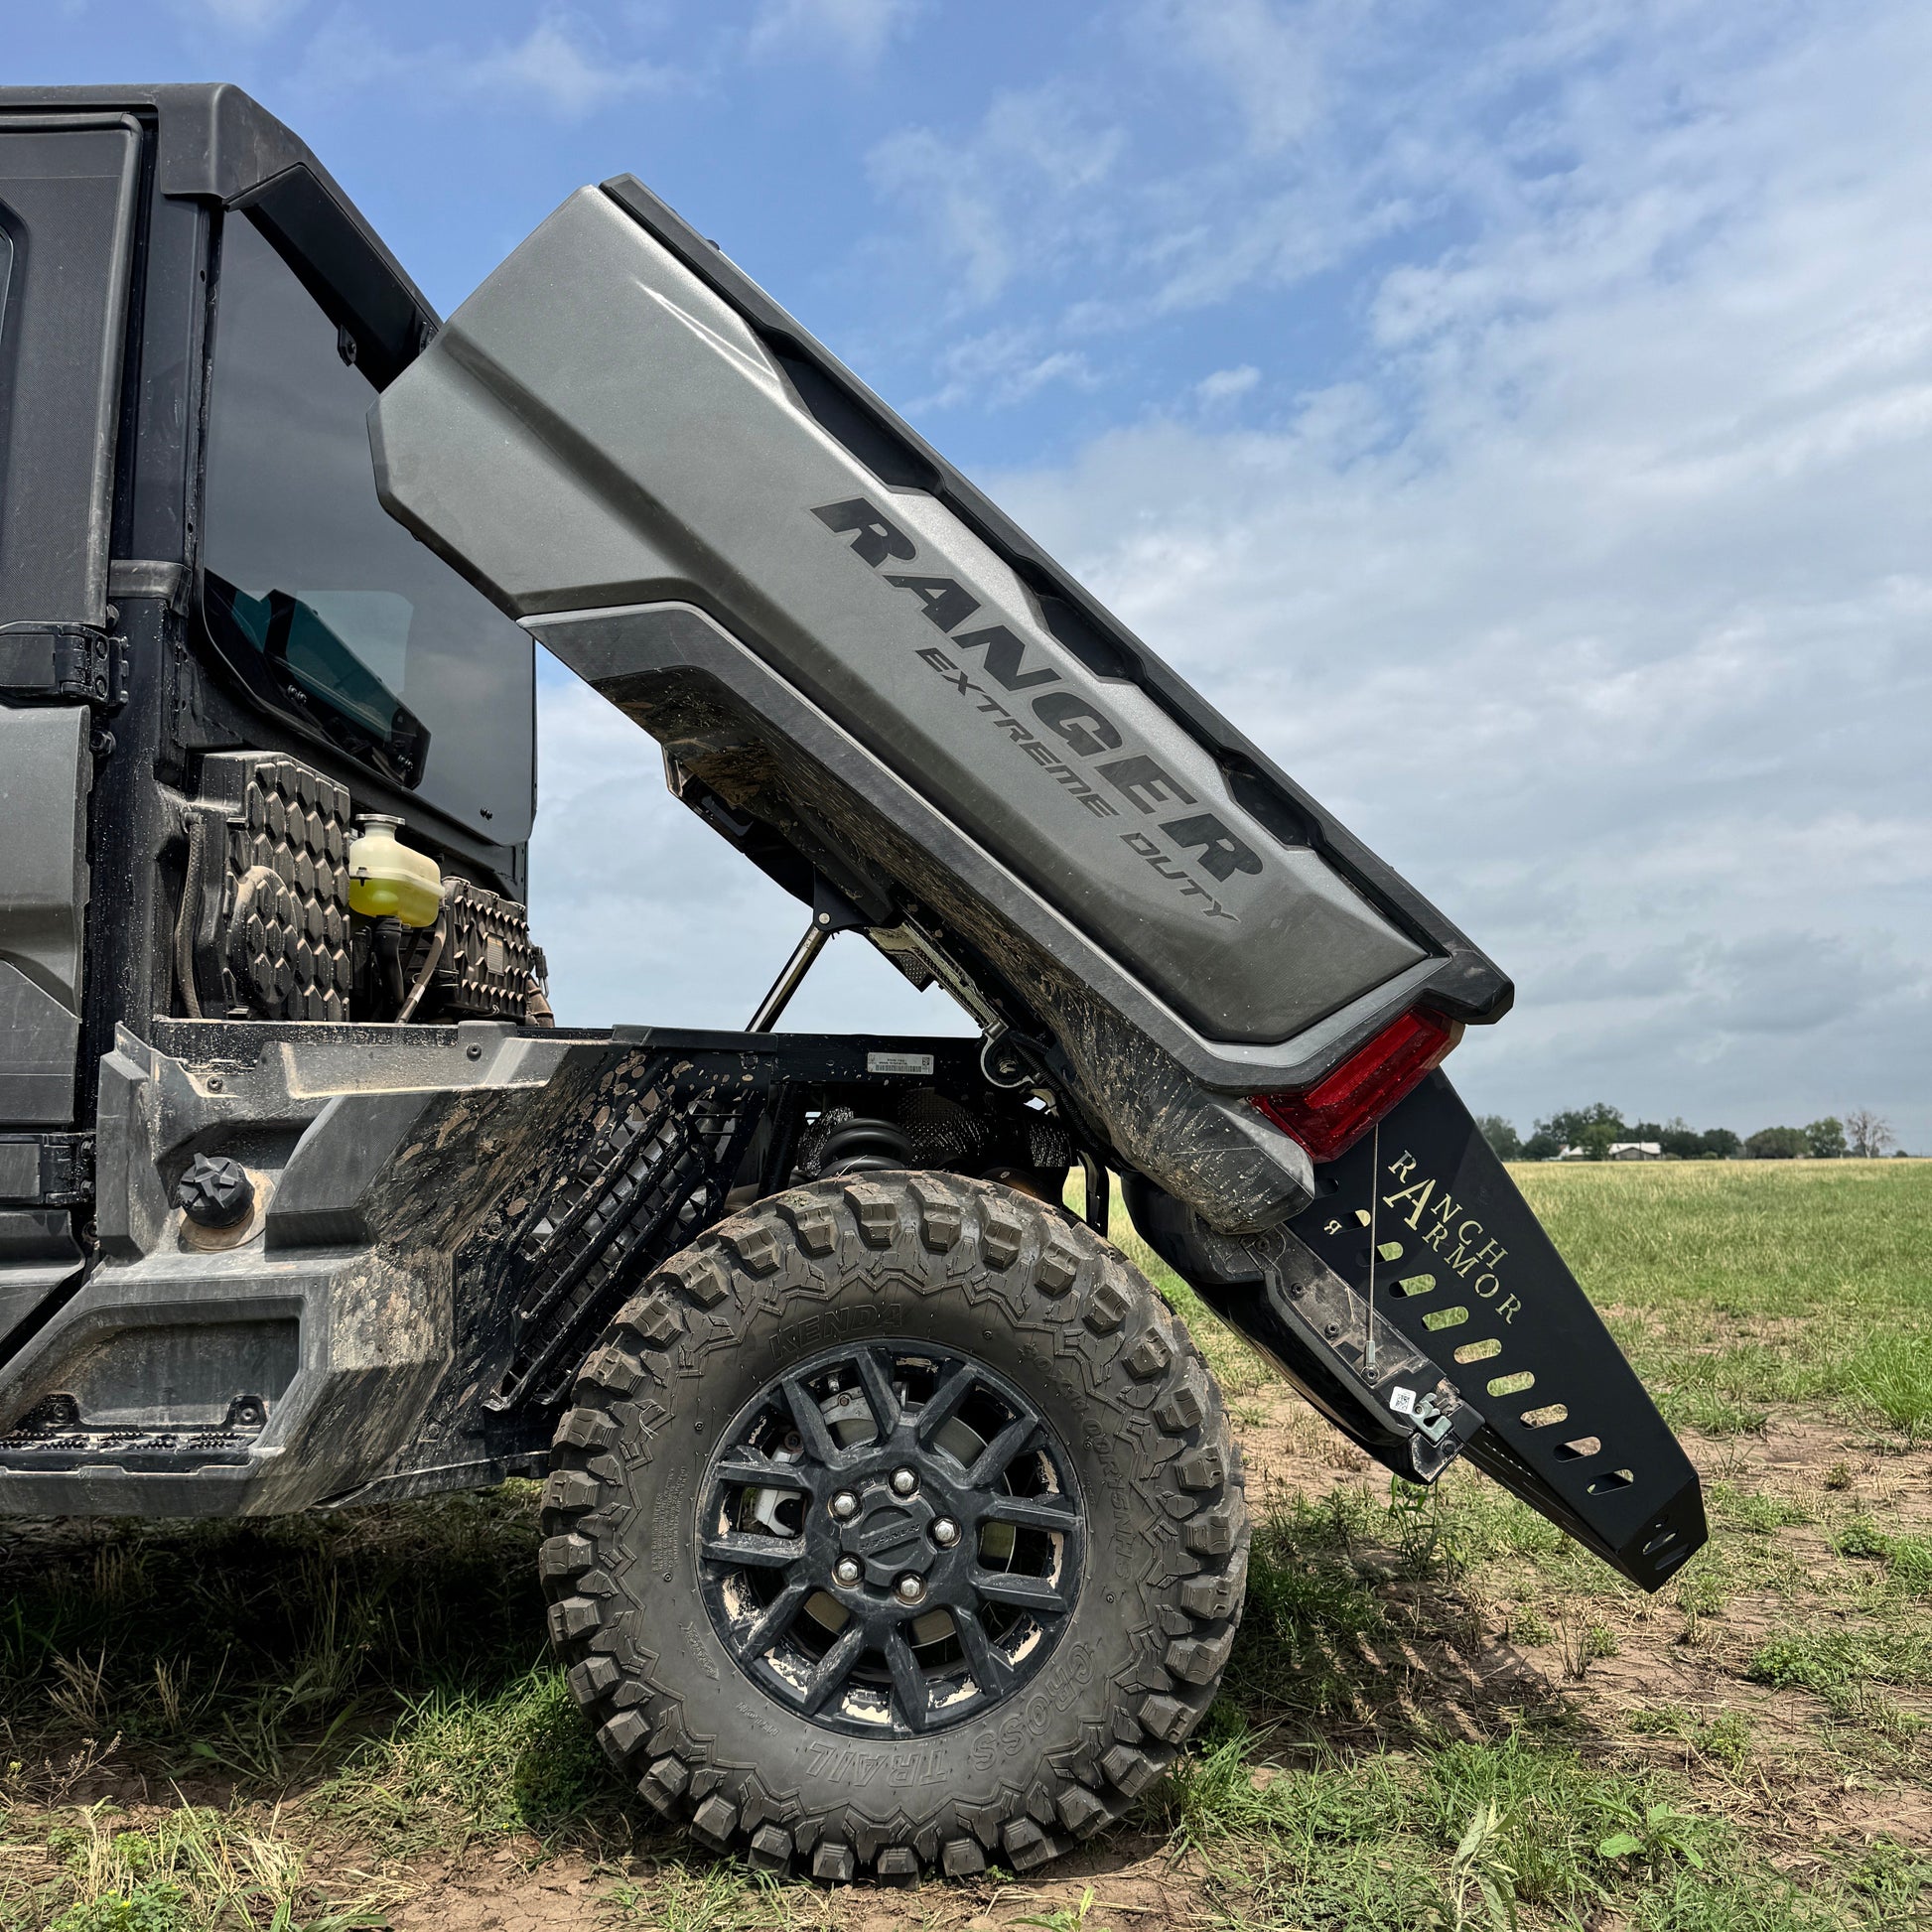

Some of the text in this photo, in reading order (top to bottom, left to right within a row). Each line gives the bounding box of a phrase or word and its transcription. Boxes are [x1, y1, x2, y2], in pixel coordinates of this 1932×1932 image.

[810, 497, 1264, 883] RANGER
[915, 647, 1239, 922] EXTREME DUTY
[1383, 1150, 1509, 1271] RANCH
[1383, 1178, 1523, 1324] ARMOR
[768, 1303, 901, 1361] KENDA
[804, 1640, 1095, 1788] CROSS TRAIL
